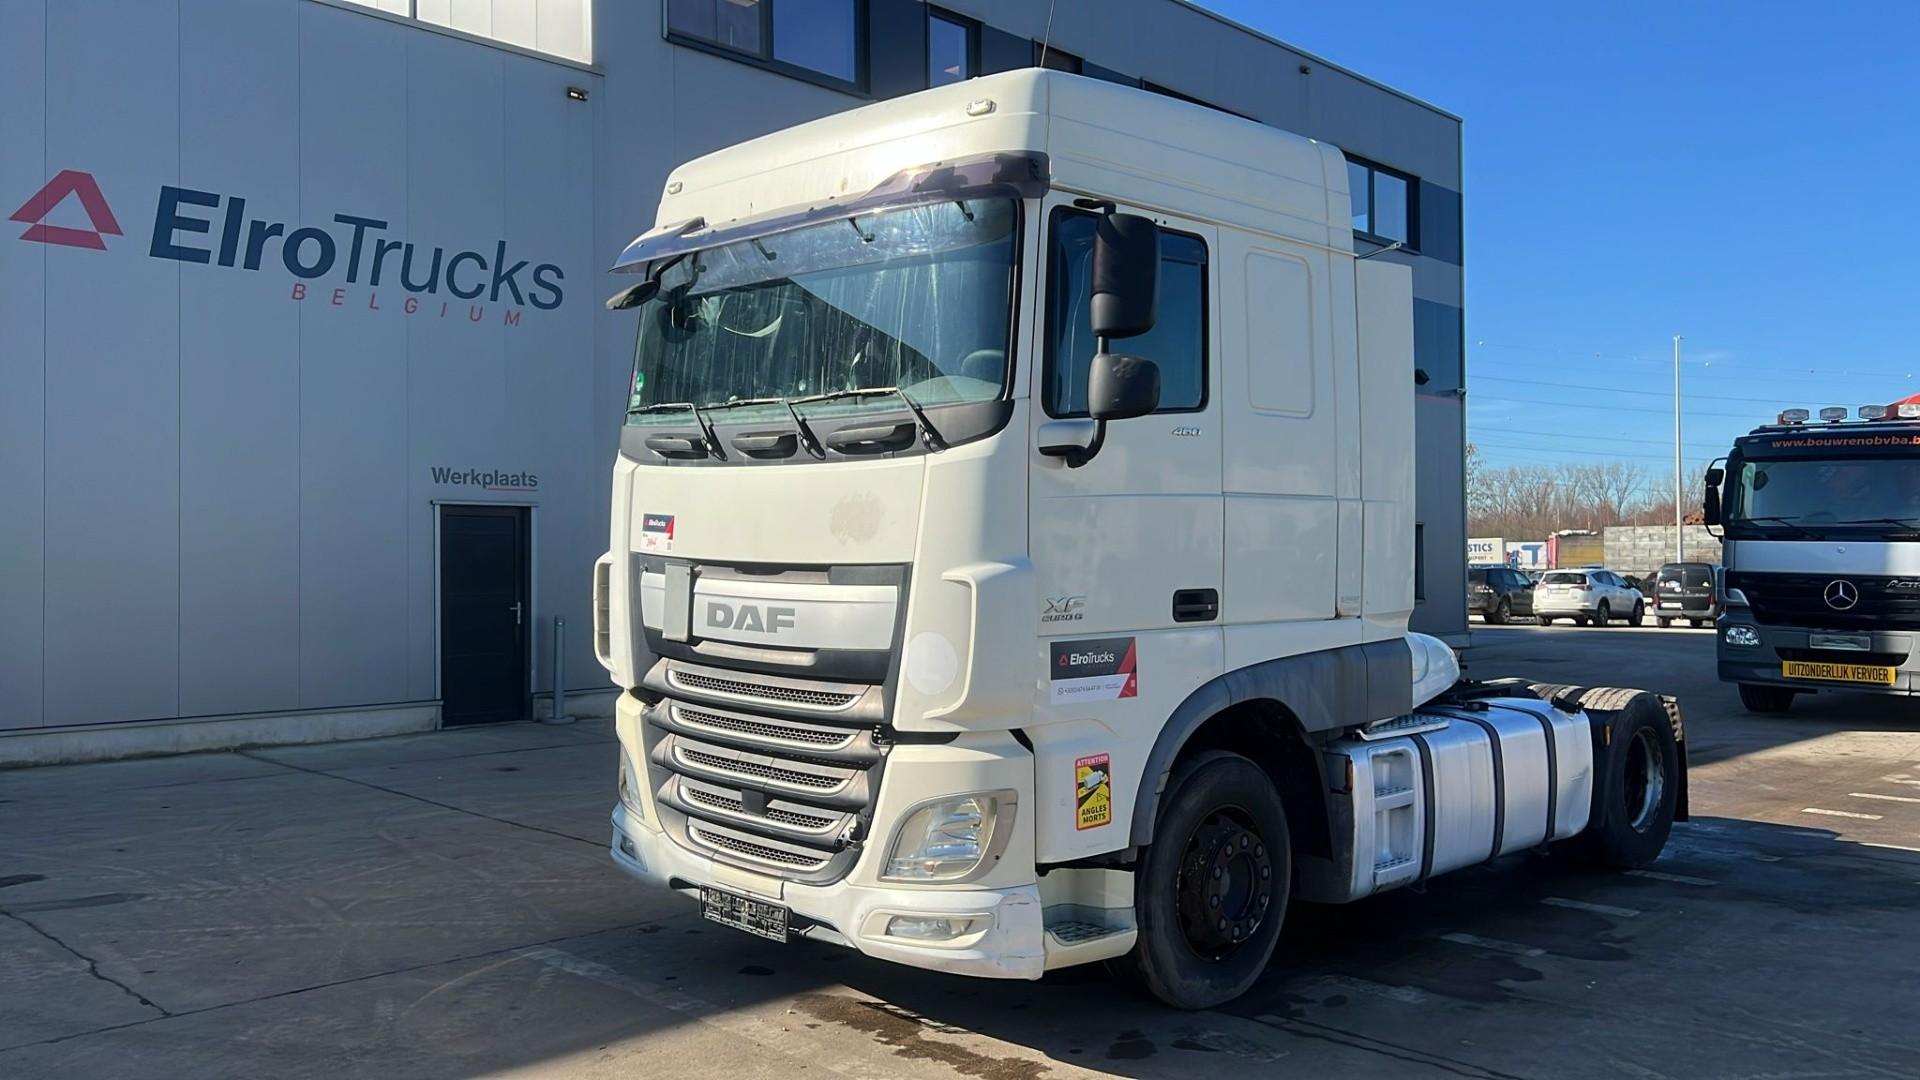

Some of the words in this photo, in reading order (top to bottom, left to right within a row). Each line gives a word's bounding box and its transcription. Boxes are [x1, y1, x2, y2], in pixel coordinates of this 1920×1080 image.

[149, 185, 565, 310] ElroTrucks
[291, 283, 521, 327] BELGIUM
[431, 466, 538, 489] Werkplaats
[1043, 596, 1086, 614] XF
[706, 602, 796, 633] DAF
[1069, 651, 1115, 666] ElroTrucks
[1788, 663, 1849, 679] UITZONDERLIJK
[1850, 666, 1889, 682] VERVOER
[1076, 755, 1109, 767] ATTENTION
[1081, 804, 1107, 817] ANGLES
[1083, 812, 1106, 824] MORTS
